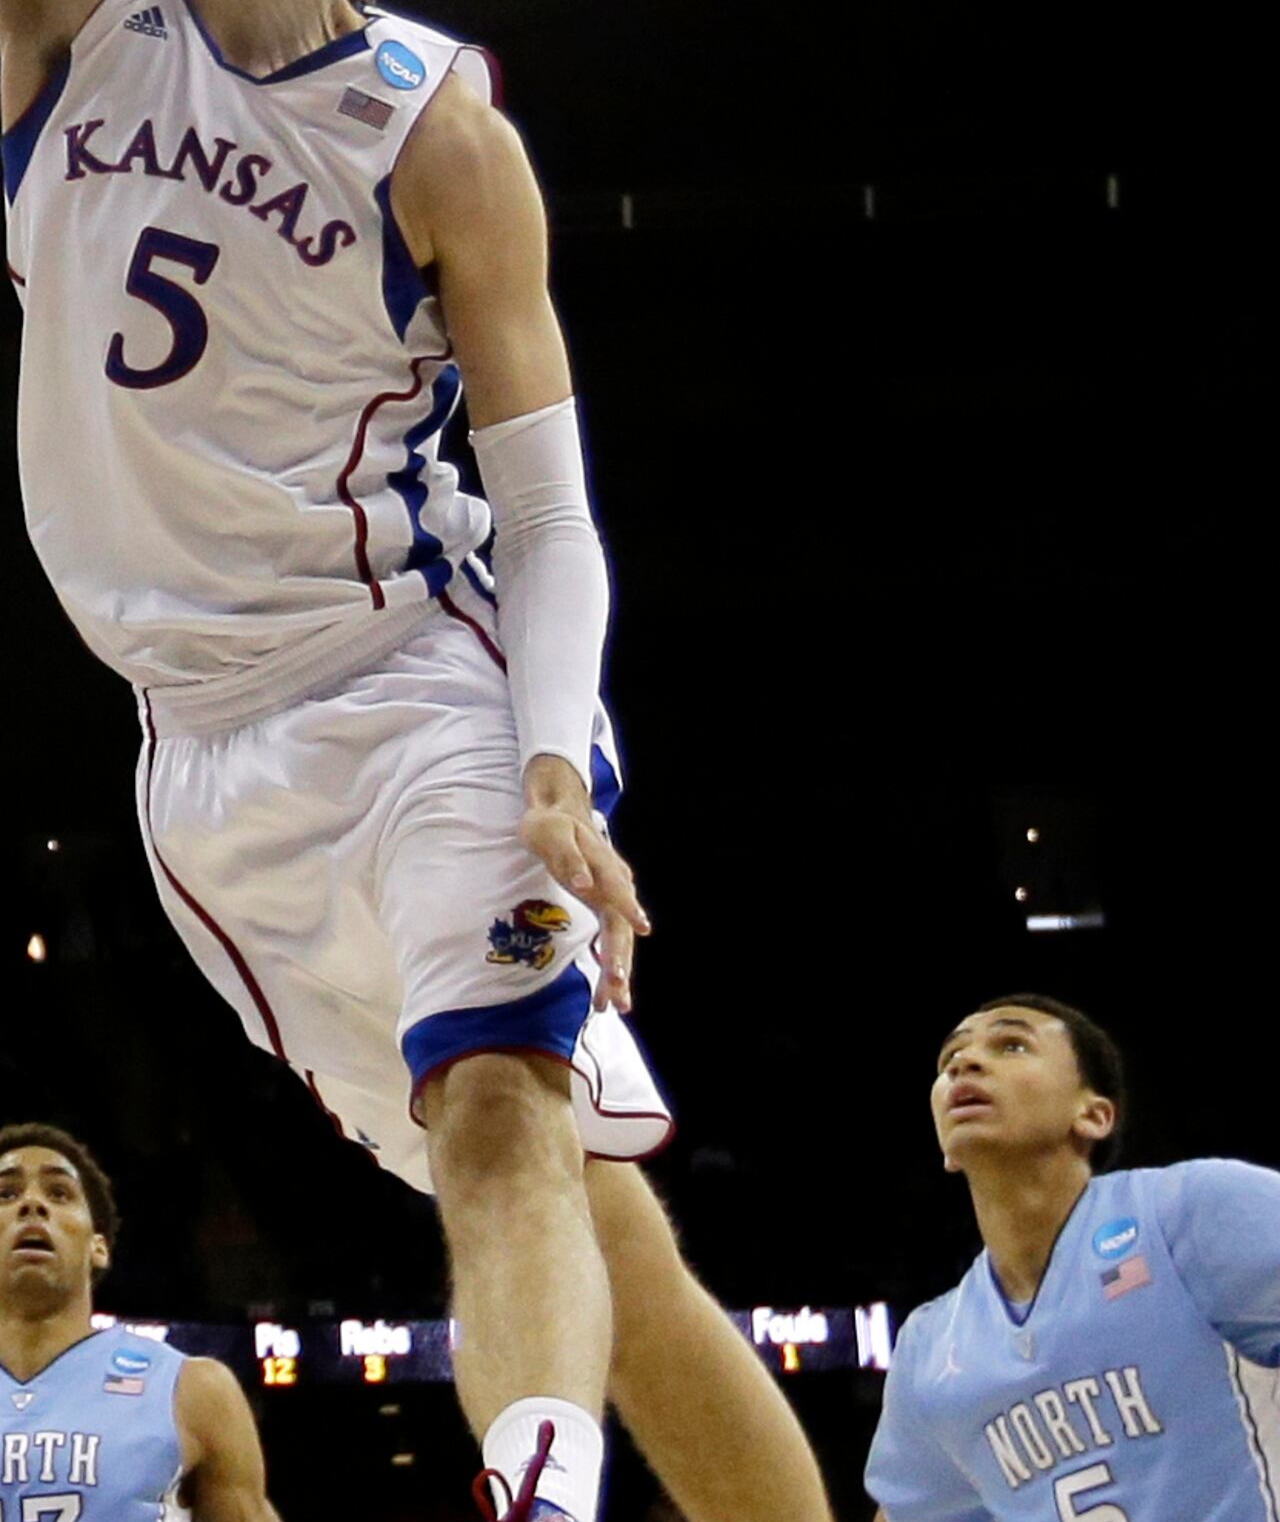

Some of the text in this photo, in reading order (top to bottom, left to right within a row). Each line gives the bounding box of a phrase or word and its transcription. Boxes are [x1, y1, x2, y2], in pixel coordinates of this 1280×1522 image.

[123, 19, 168, 41] adidas
[63, 119, 357, 267] KANSAS
[104, 226, 220, 390] 5
[263, 1358, 297, 1385] 12
[984, 1366, 1163, 1491] NORTH
